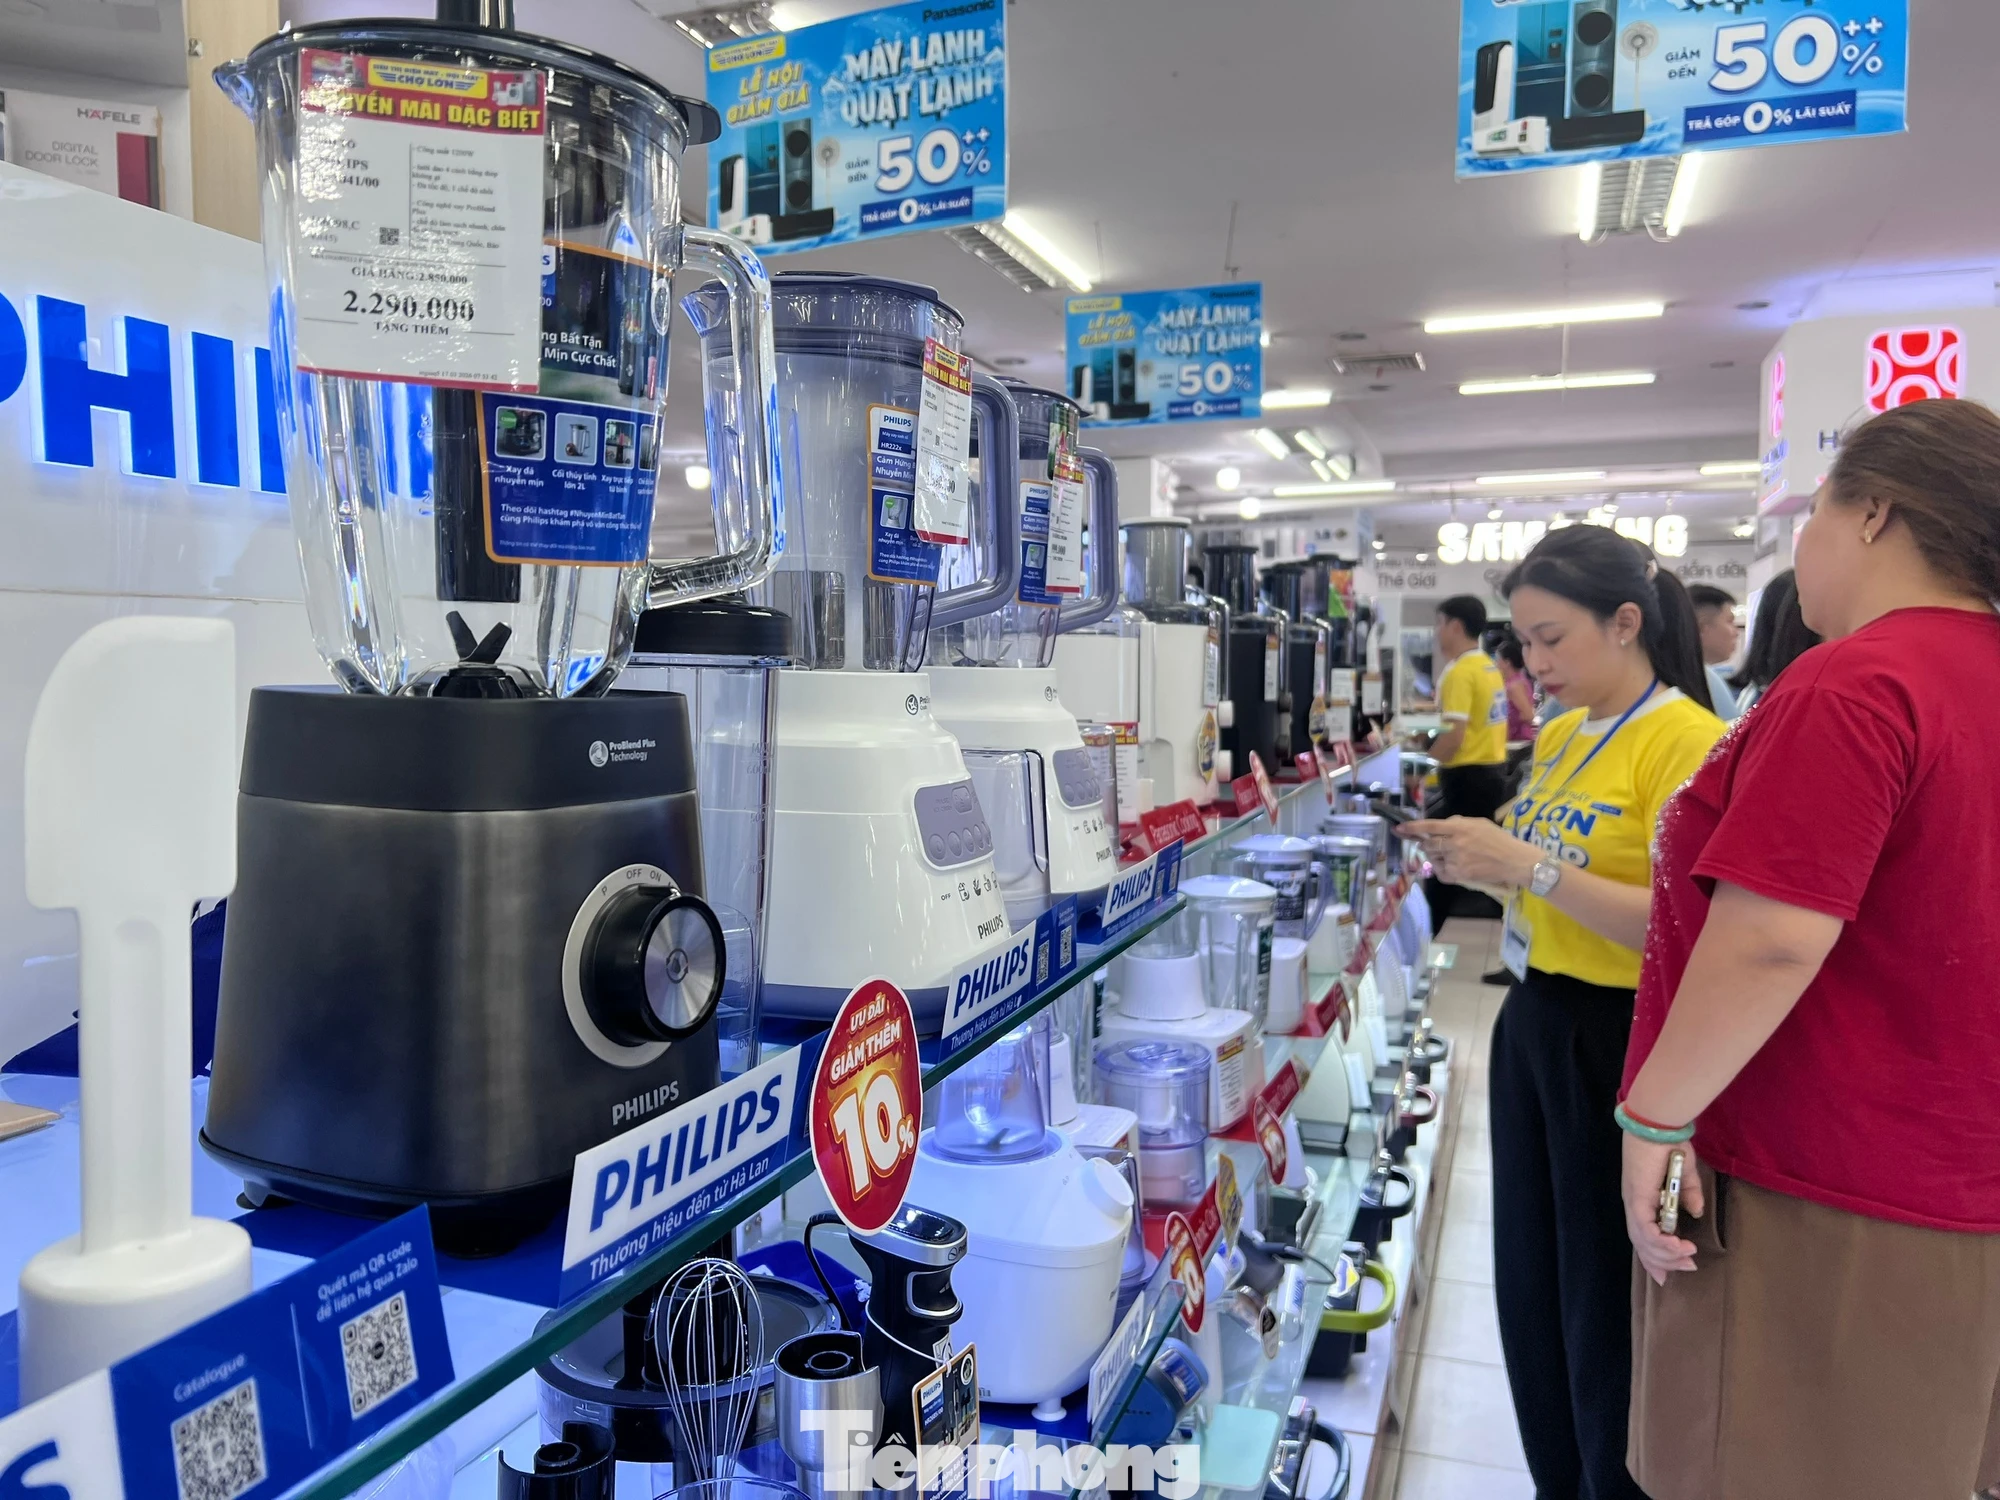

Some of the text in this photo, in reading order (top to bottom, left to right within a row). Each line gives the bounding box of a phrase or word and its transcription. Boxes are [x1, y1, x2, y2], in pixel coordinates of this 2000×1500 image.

[923, 0, 996, 22] Panasonic
[845, 29, 986, 82] MÁY LẠNH
[1665, 47, 1700, 63] GIẢM
[1668, 65, 1697, 79] ĐẾN
[398, 75, 455, 89] CHỢ LỚN
[727, 83, 809, 125] GIẢM GIÁ
[841, 66, 994, 128] QUẠT LẠNH
[400, 100, 441, 121] MÃI
[448, 105, 491, 129] ĐẶC
[498, 109, 541, 132] BIỆT
[1687, 115, 1712, 131] TRẢ
[1714, 114, 1741, 127] GÓP
[1795, 108, 1816, 120] LÃI
[1818, 101, 1852, 118] SUẤT
[52, 141, 99, 154] DIGITAL
[25, 150, 99, 167] DOOR LOCK
[343, 290, 475, 322] 2.290.000
[413, 322, 450, 337] THÊM
[560, 332, 602, 349] Bất Tận
[544, 349, 617, 368] Mịn Cực Chất
[884, 415, 911, 427] PHILIPS
[881, 442, 902, 451] HR222x
[506, 465, 534, 478] Xay đá
[895, 457, 911, 469] Hứng
[495, 475, 544, 488] nhuyễn mịn
[501, 503, 522, 513] Theo
[538, 507, 568, 518] hashtag
[523, 514, 549, 525] Philips
[550, 517, 571, 527] khám
[609, 739, 656, 751] ProBlend Plus
[610, 751, 648, 761] Technology
[626, 869, 642, 880] OFF
[650, 870, 662, 882] ON
[602, 886, 608, 896] P
[941, 893, 951, 901] OFF
[1109, 865, 1153, 914] PHILIPS
[978, 914, 1004, 939] PHILIPS
[953, 938, 1030, 1019] PHILIPS
[851, 1007, 867, 1033] ƯU
[951, 1025, 974, 1050] Thương
[975, 1017, 988, 1034] hiệu
[988, 1006, 999, 1026] đến
[830, 1019, 901, 1082] GIẢM THÊM
[612, 1080, 679, 1126] PHILIPS
[589, 1073, 782, 1234] PHILIPS
[590, 1157, 769, 1281] Thương hiệu đến từ Hà Lan
[317, 1275, 348, 1300] Quét
[369, 1253, 386, 1273] QR
[387, 1240, 412, 1263] code
[374, 1269, 394, 1291] qua
[395, 1256, 418, 1278] Zalo
[173, 1353, 246, 1403] Catalogue
[922, 1380, 942, 1401] PHILIPS
